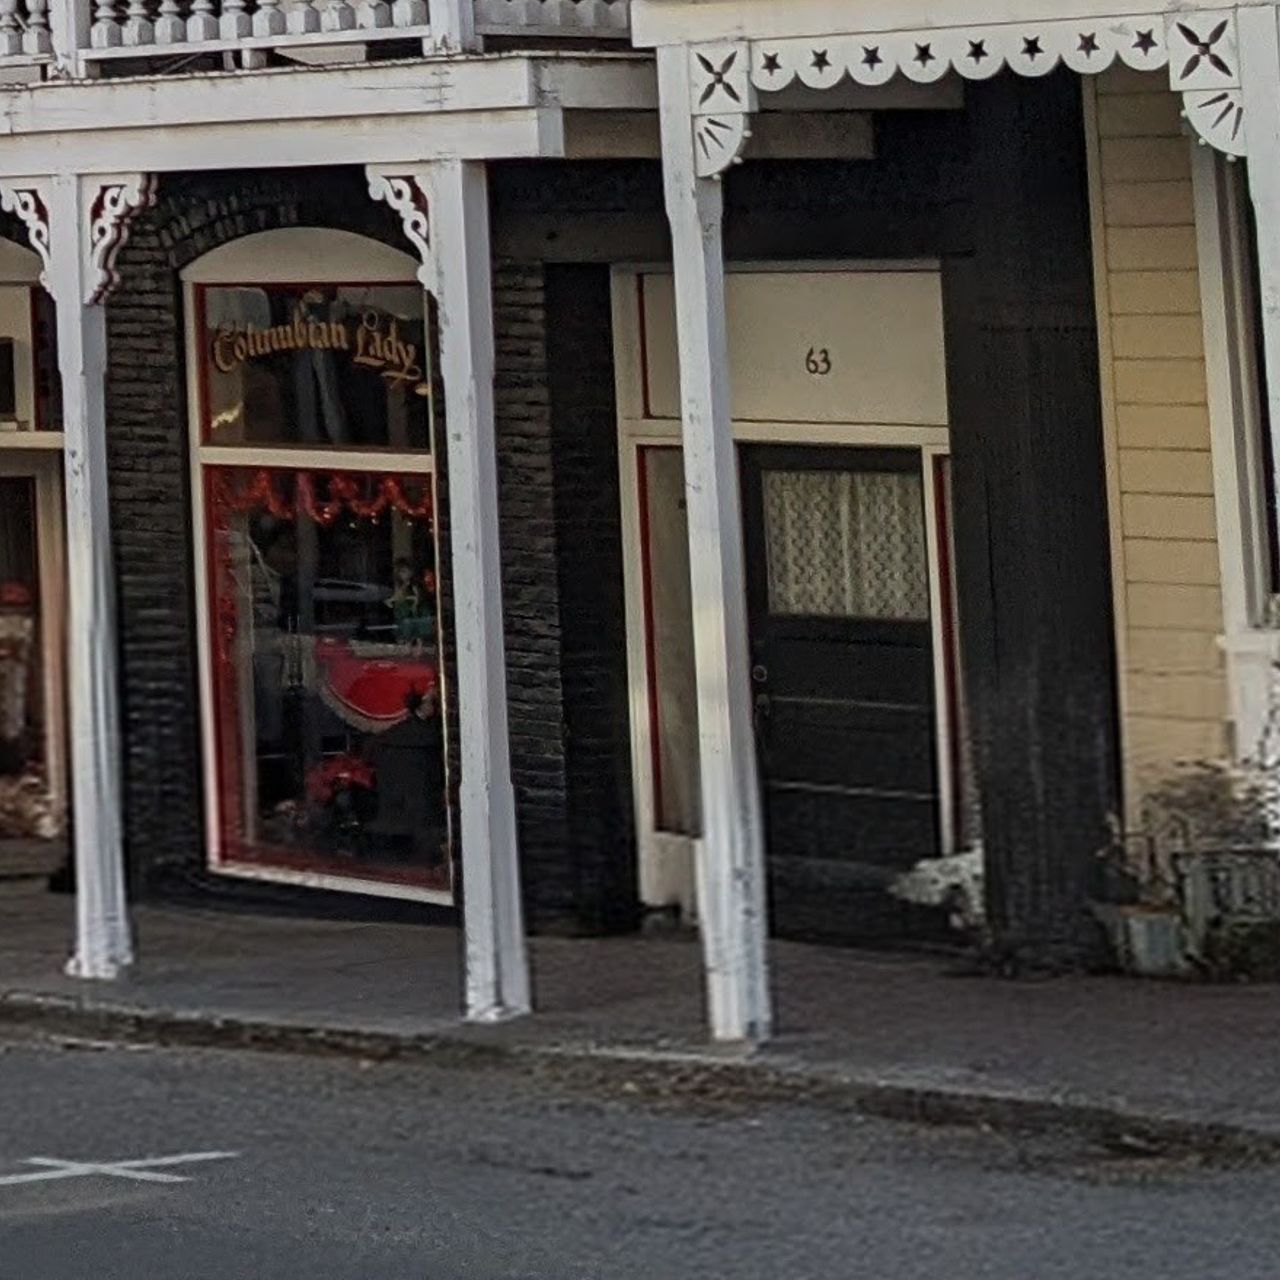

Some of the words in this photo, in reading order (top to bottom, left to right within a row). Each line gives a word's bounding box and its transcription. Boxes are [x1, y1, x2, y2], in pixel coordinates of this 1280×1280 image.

[214, 304, 348, 371] Columbian
[353, 310, 423, 384] Lady
[805, 346, 832, 375] 63
